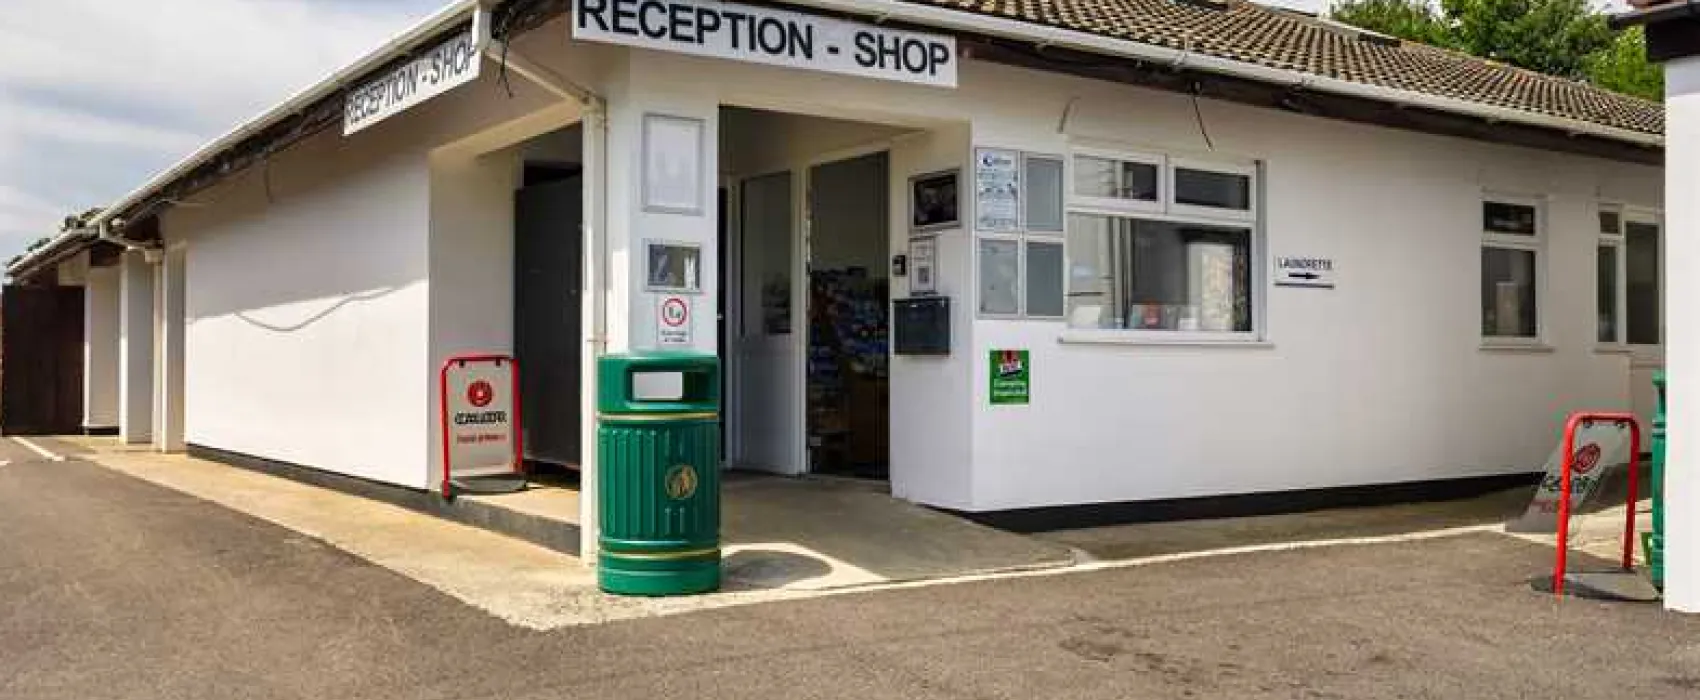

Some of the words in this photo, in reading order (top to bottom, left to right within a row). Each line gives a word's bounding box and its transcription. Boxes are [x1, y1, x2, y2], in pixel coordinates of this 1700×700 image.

[577, 0, 813, 60] RECEPTION
[827, 46, 839, 55] -
[855, 31, 950, 76] SHOP
[346, 63, 418, 125] RECEPTION
